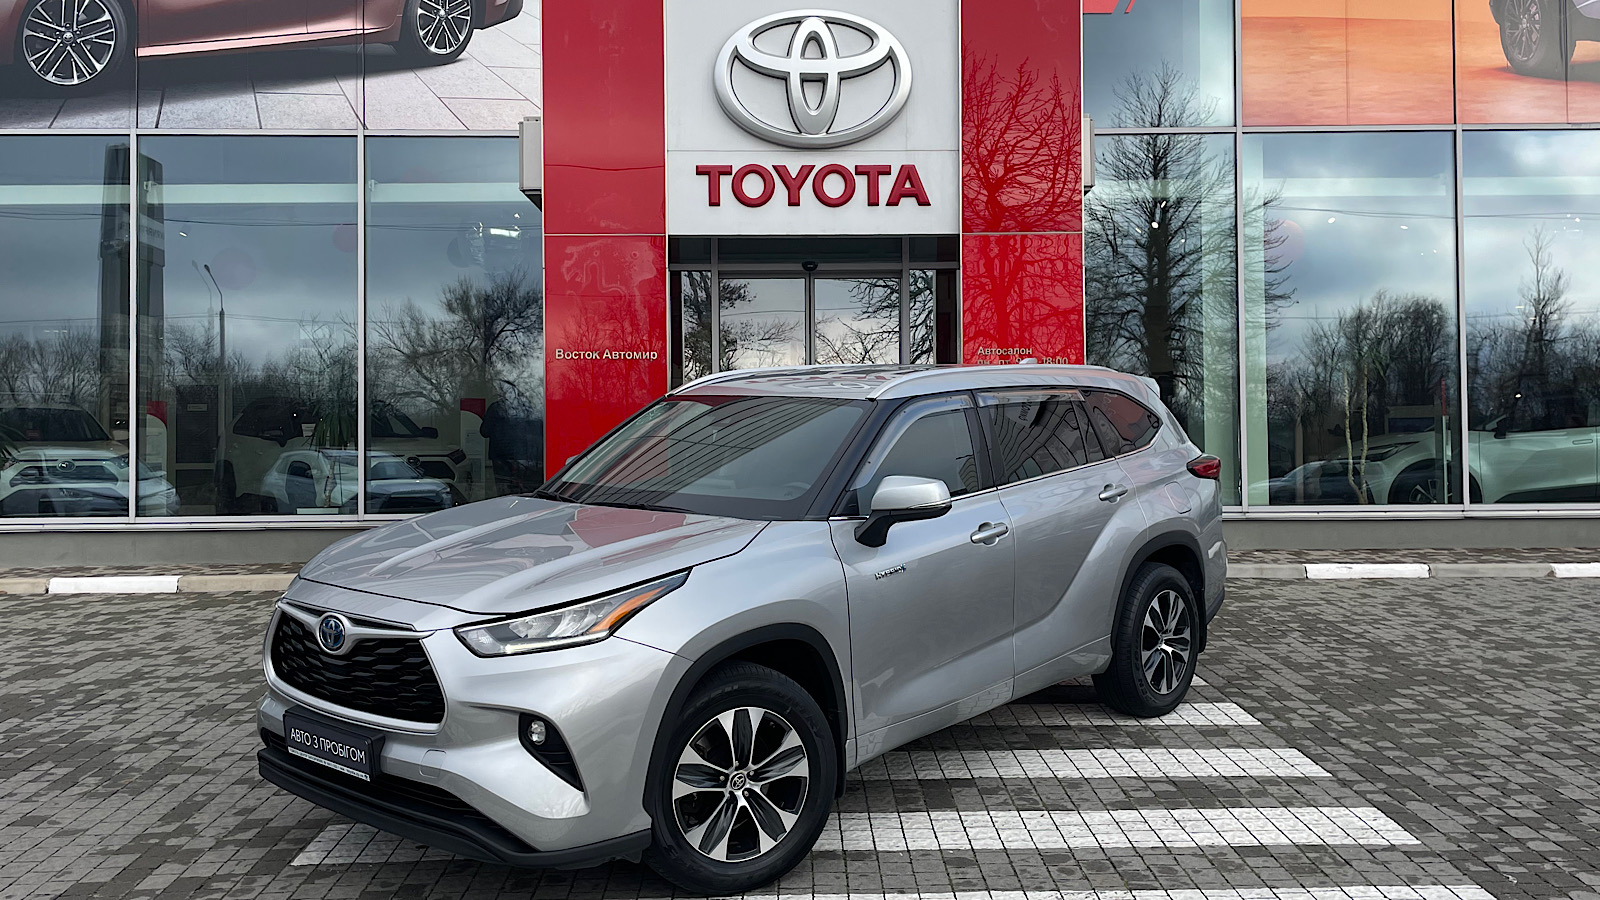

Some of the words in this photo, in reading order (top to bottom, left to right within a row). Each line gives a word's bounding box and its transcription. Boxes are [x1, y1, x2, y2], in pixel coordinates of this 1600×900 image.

[695, 163, 932, 208] TOYOTA
[555, 348, 600, 360] Восток
[602, 348, 658, 362] Автомир
[977, 346, 1033, 355] Автосалон
[290, 727, 312, 746] АВТО
[319, 737, 366, 765] ПРОБІГОМ
